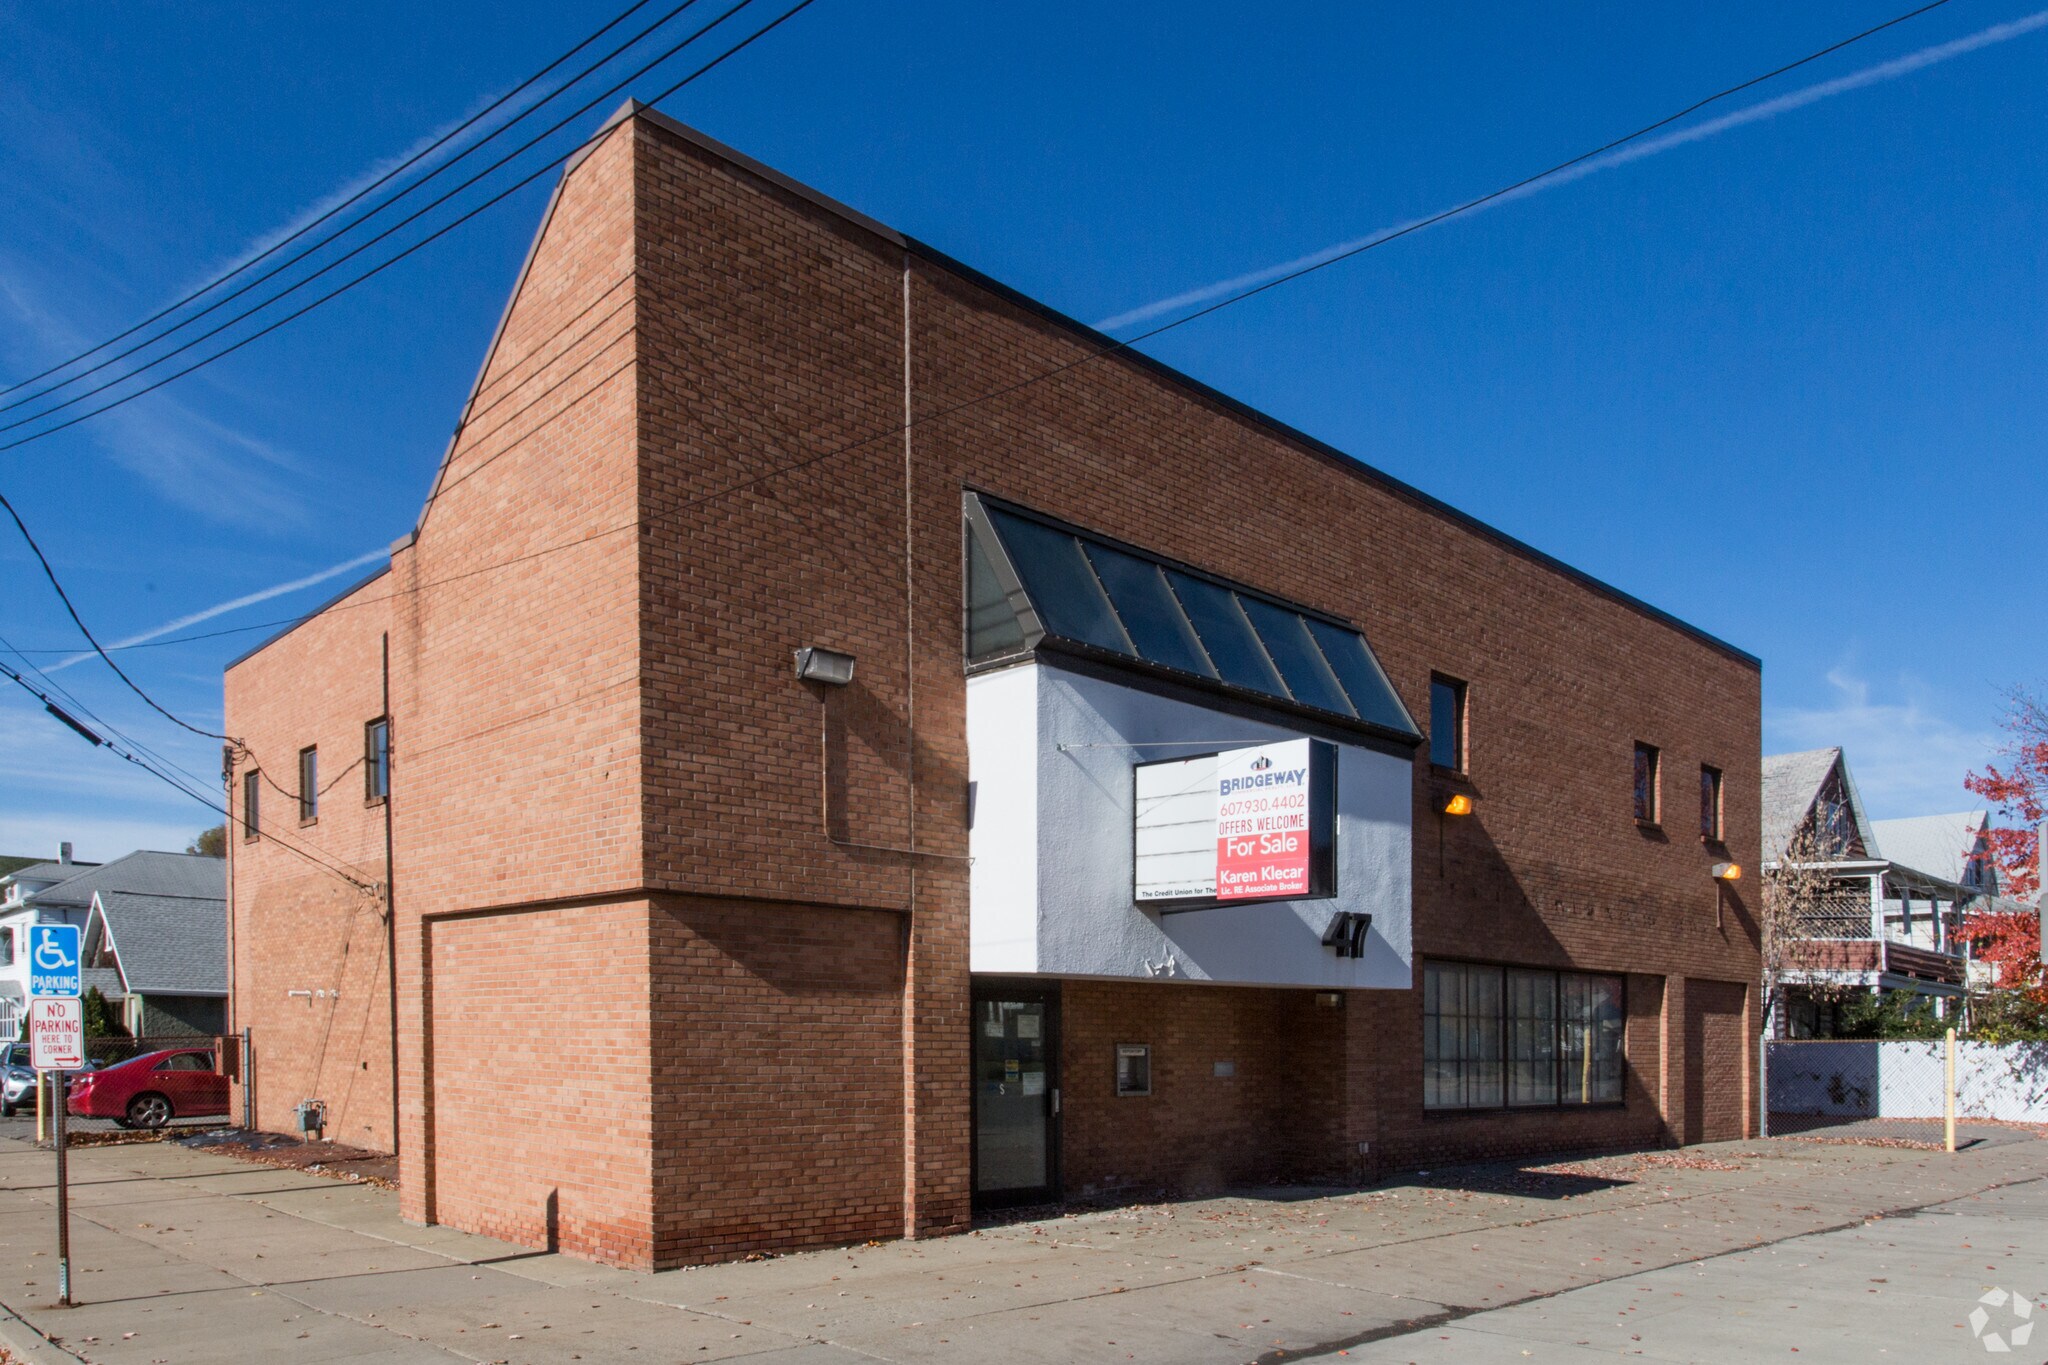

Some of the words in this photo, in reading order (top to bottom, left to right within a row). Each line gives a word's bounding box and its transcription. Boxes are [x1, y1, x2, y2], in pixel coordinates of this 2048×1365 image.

[1220, 768, 1306, 796] BRIDGEWAY
[1220, 793, 1305, 817] 607.930.4402
[1219, 818, 1253, 835] OFFERS
[1257, 813, 1305, 831] WELCOME
[1227, 837, 1256, 858] For
[1260, 832, 1298, 855] Sale
[1220, 870, 1258, 884] Karen
[1261, 865, 1304, 881] Klecar
[1221, 886, 1233, 895] Lic.
[1234, 885, 1244, 894] RE
[1245, 884, 1278, 893] Associate
[1279, 881, 1304, 891] Broker
[1322, 911, 1372, 958] 47
[32, 975, 78, 990] PARKING
[47, 1004, 66, 1018] NO
[35, 1019, 79, 1033] PARKING
[42, 1034, 61, 1044] HERE
[64, 1034, 73, 1043] TO
[43, 1044, 72, 1054] CORNER
